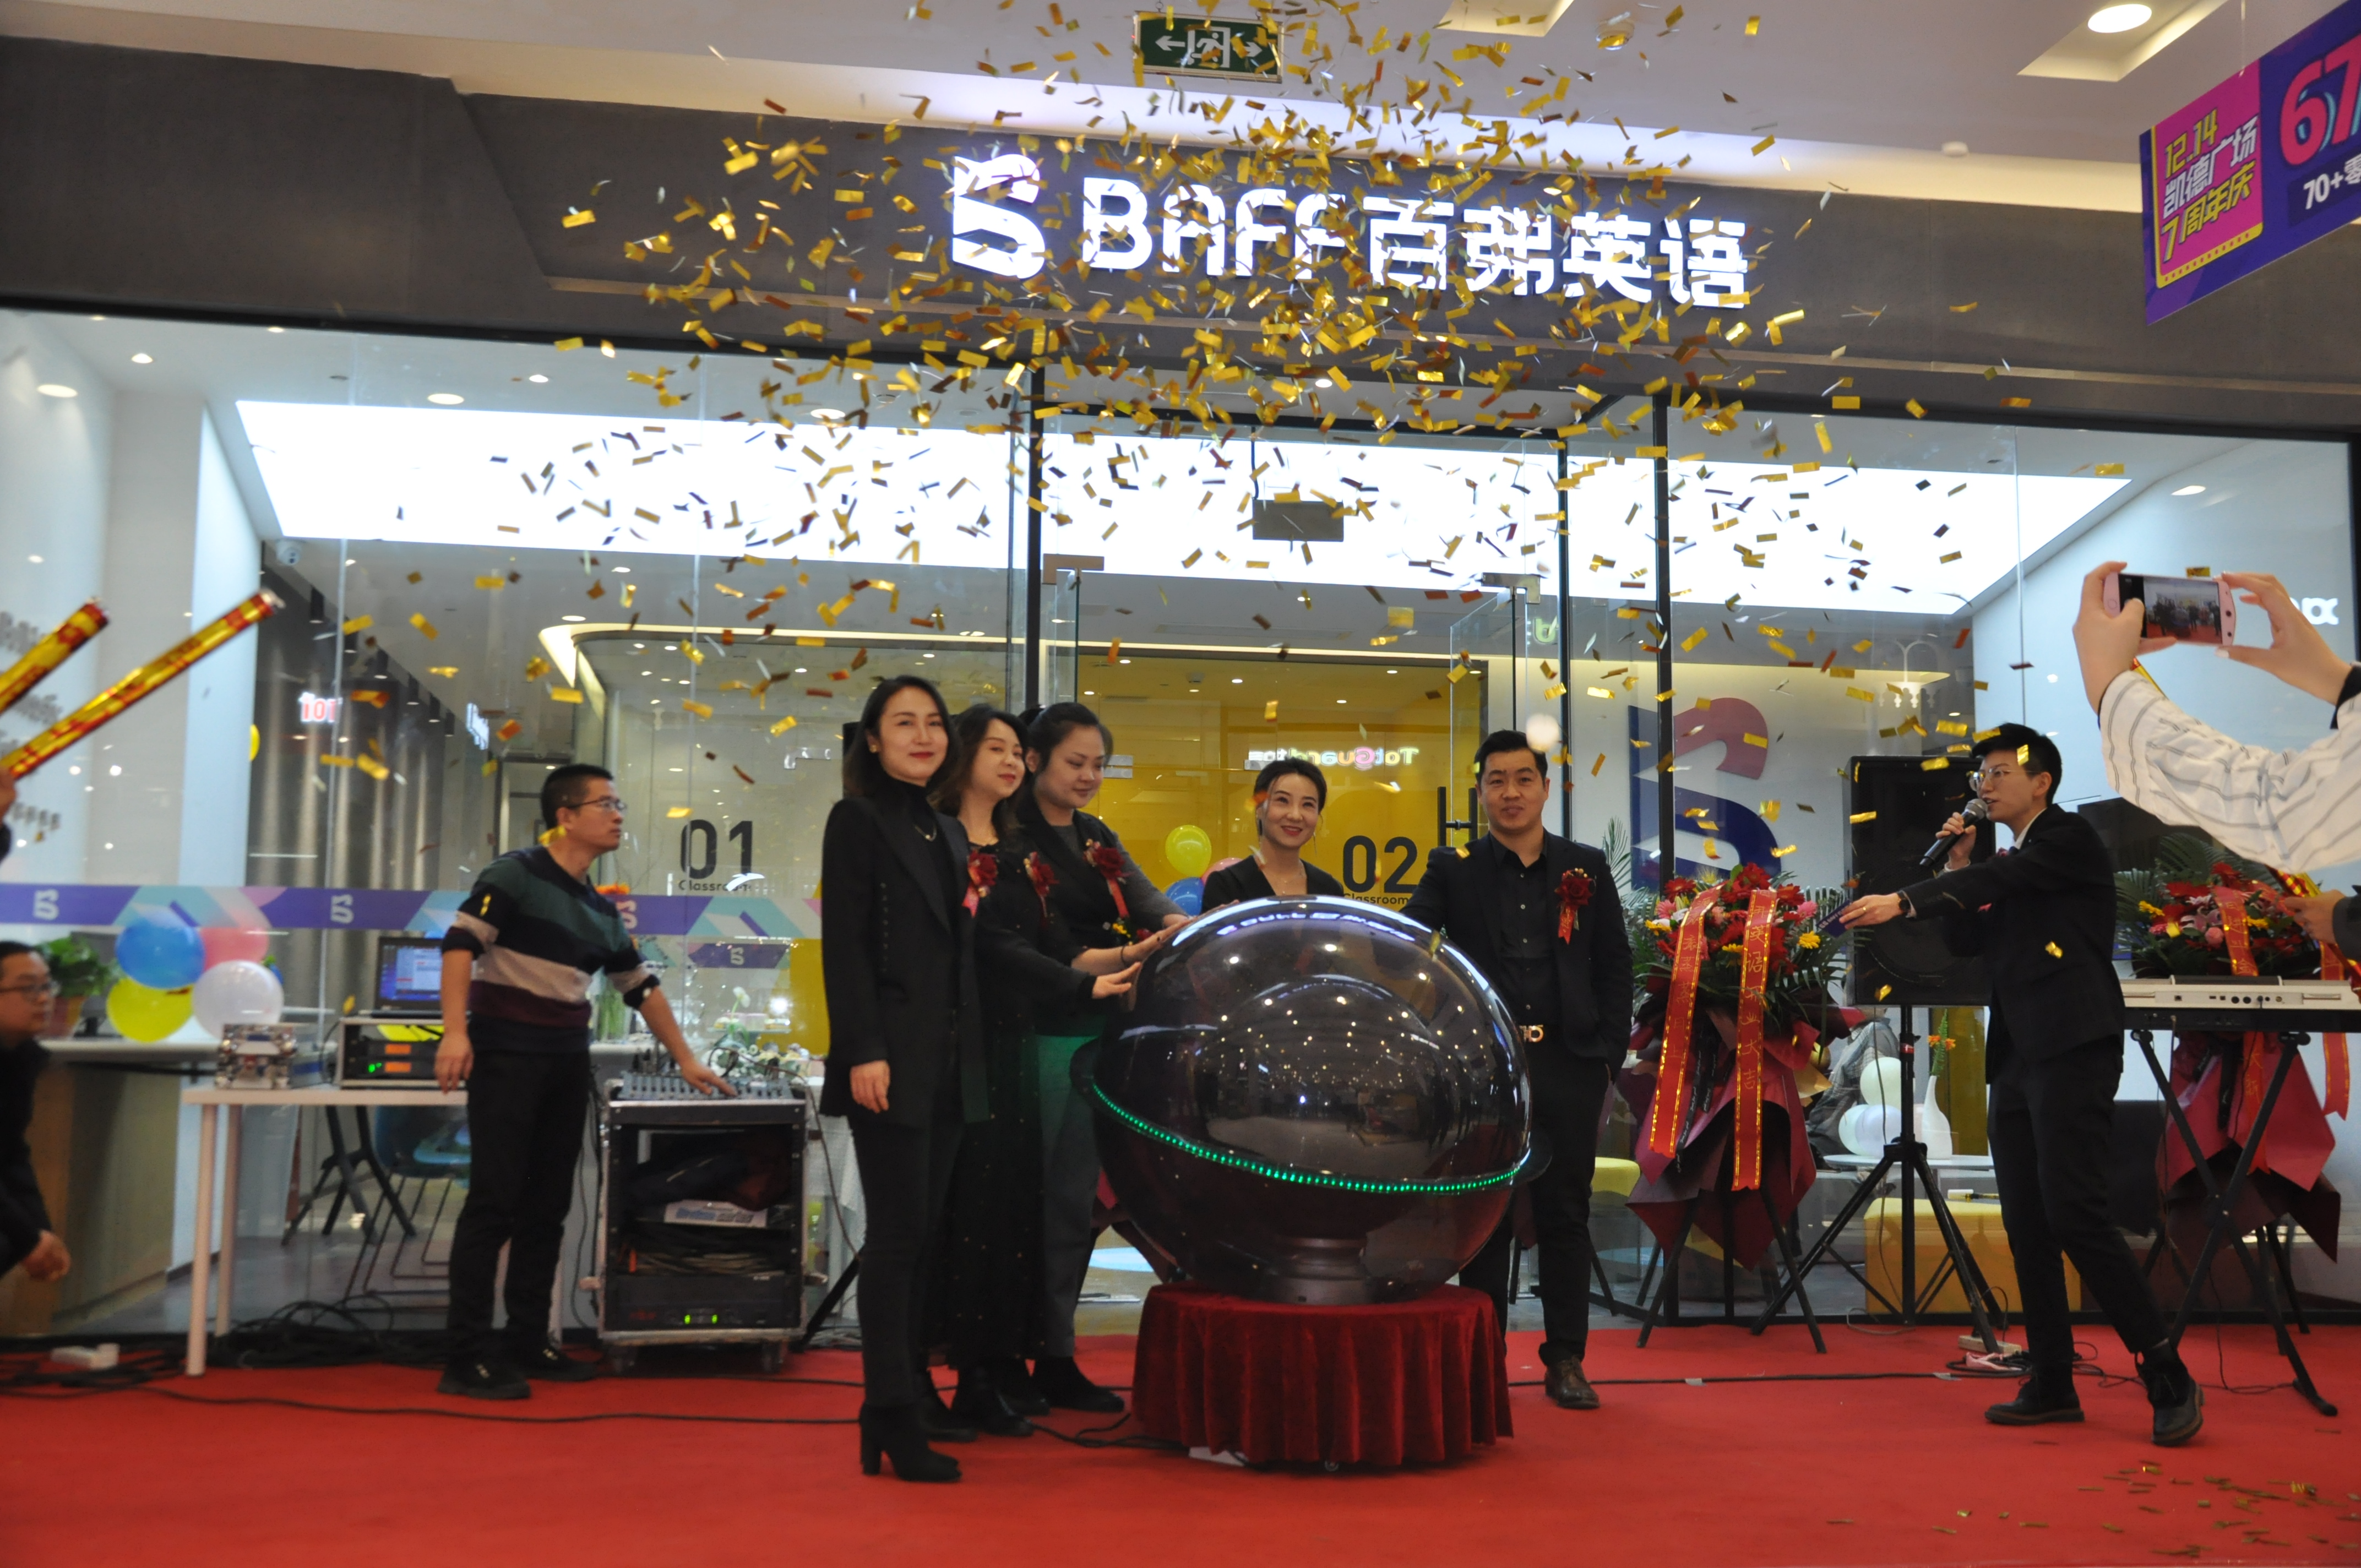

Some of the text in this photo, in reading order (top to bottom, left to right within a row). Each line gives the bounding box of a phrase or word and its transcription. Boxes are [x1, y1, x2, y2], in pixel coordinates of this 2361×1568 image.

[2162, 114, 2258, 219] 凯德广场
[2165, 108, 2218, 178] 12.14
[1082, 177, 1346, 280] BAFF
[1363, 195, 1748, 308] 百弗英语
[2161, 159, 2256, 263] 7周年庆
[681, 819, 753, 879] 01
[1342, 835, 1418, 893] 02
[678, 879, 753, 891] Classro
